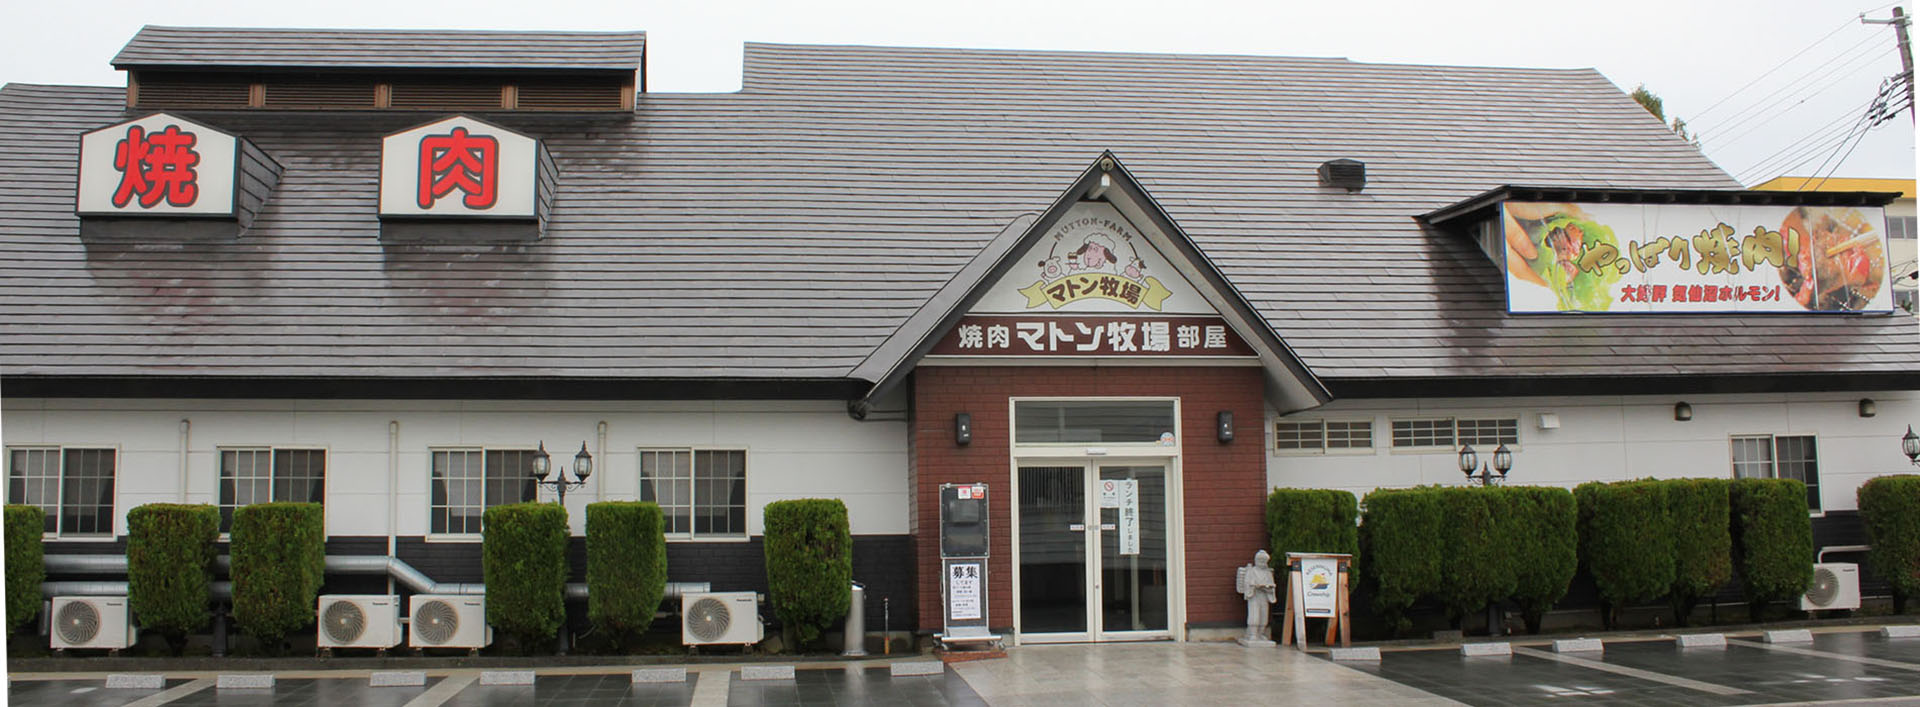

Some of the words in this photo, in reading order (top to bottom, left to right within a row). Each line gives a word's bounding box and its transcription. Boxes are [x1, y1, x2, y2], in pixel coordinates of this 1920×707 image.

[113, 125, 200, 208] 焼
[417, 127, 499, 210] 肉
[1054, 217, 1132, 241] MUTTON-FARM
[1046, 276, 1142, 305] マトン牧場
